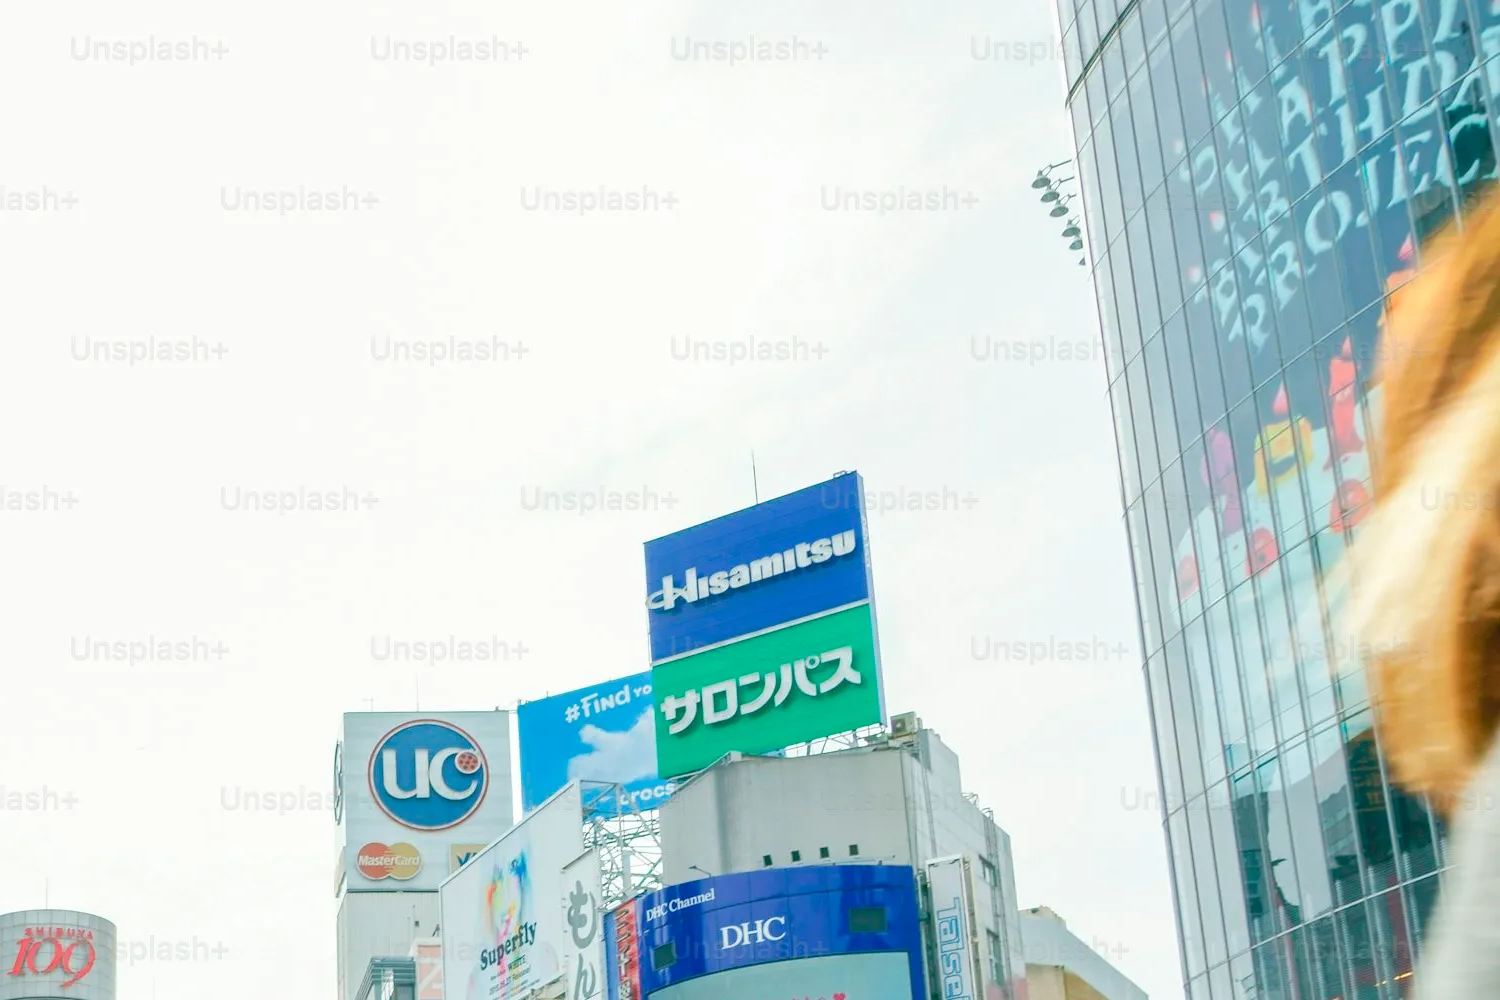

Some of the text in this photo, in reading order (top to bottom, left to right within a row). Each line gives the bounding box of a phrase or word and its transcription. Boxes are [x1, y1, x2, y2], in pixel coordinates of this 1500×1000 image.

[646, 529, 856, 611] Hisamitsu
[660, 645, 862, 735] サロンパス
[358, 854, 421, 867] MasterCard
[646, 888, 715, 922] DHC Channel
[23, 926, 94, 940] SHIBUYA
[480, 921, 537, 971] Superfly
[719, 915, 787, 950] DHC
[7, 936, 96, 988] 109
